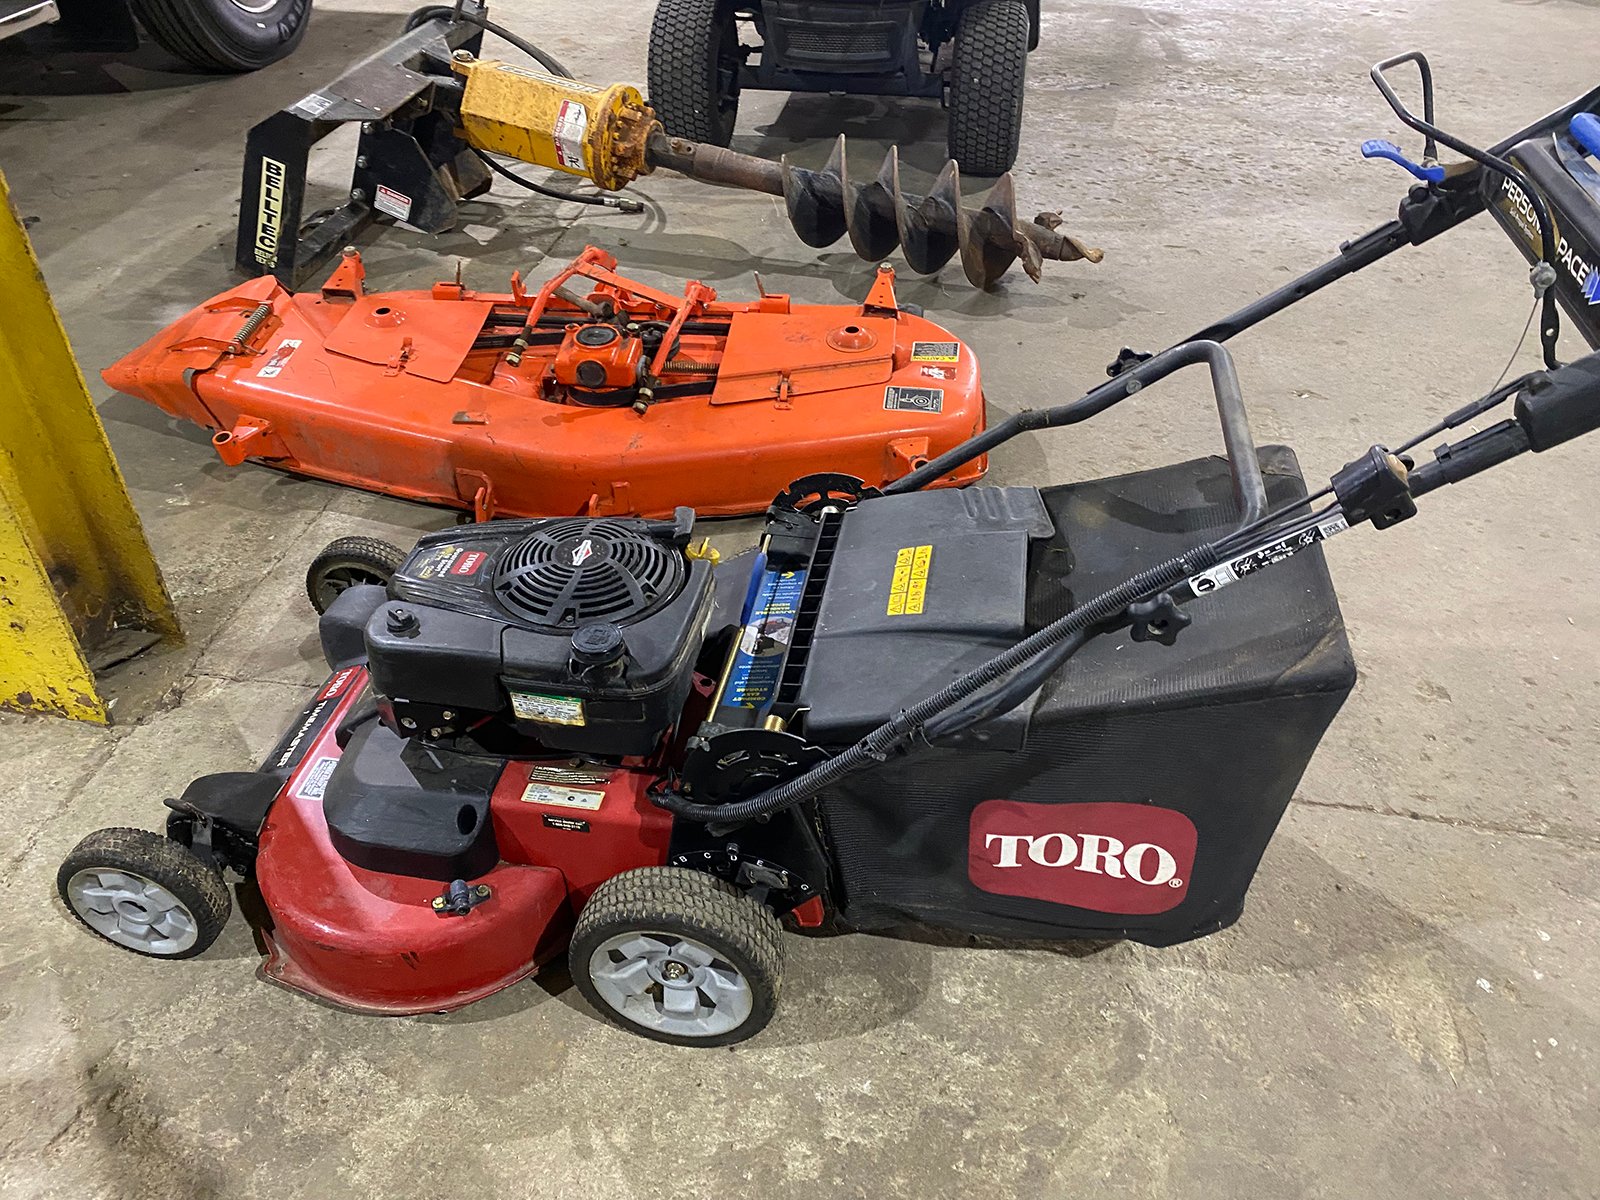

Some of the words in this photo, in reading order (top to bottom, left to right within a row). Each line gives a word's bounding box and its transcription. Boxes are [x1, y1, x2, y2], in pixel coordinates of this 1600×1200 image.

[259, 161, 282, 249] BELLTEC
[1555, 236, 1591, 286] PACE
[459, 553, 480, 573] TORO
[325, 669, 353, 698] TORO
[277, 700, 327, 767] TIMEMASTER
[679, 855, 688, 863] B
[756, 859, 764, 867] E
[800, 883, 809, 891] G
